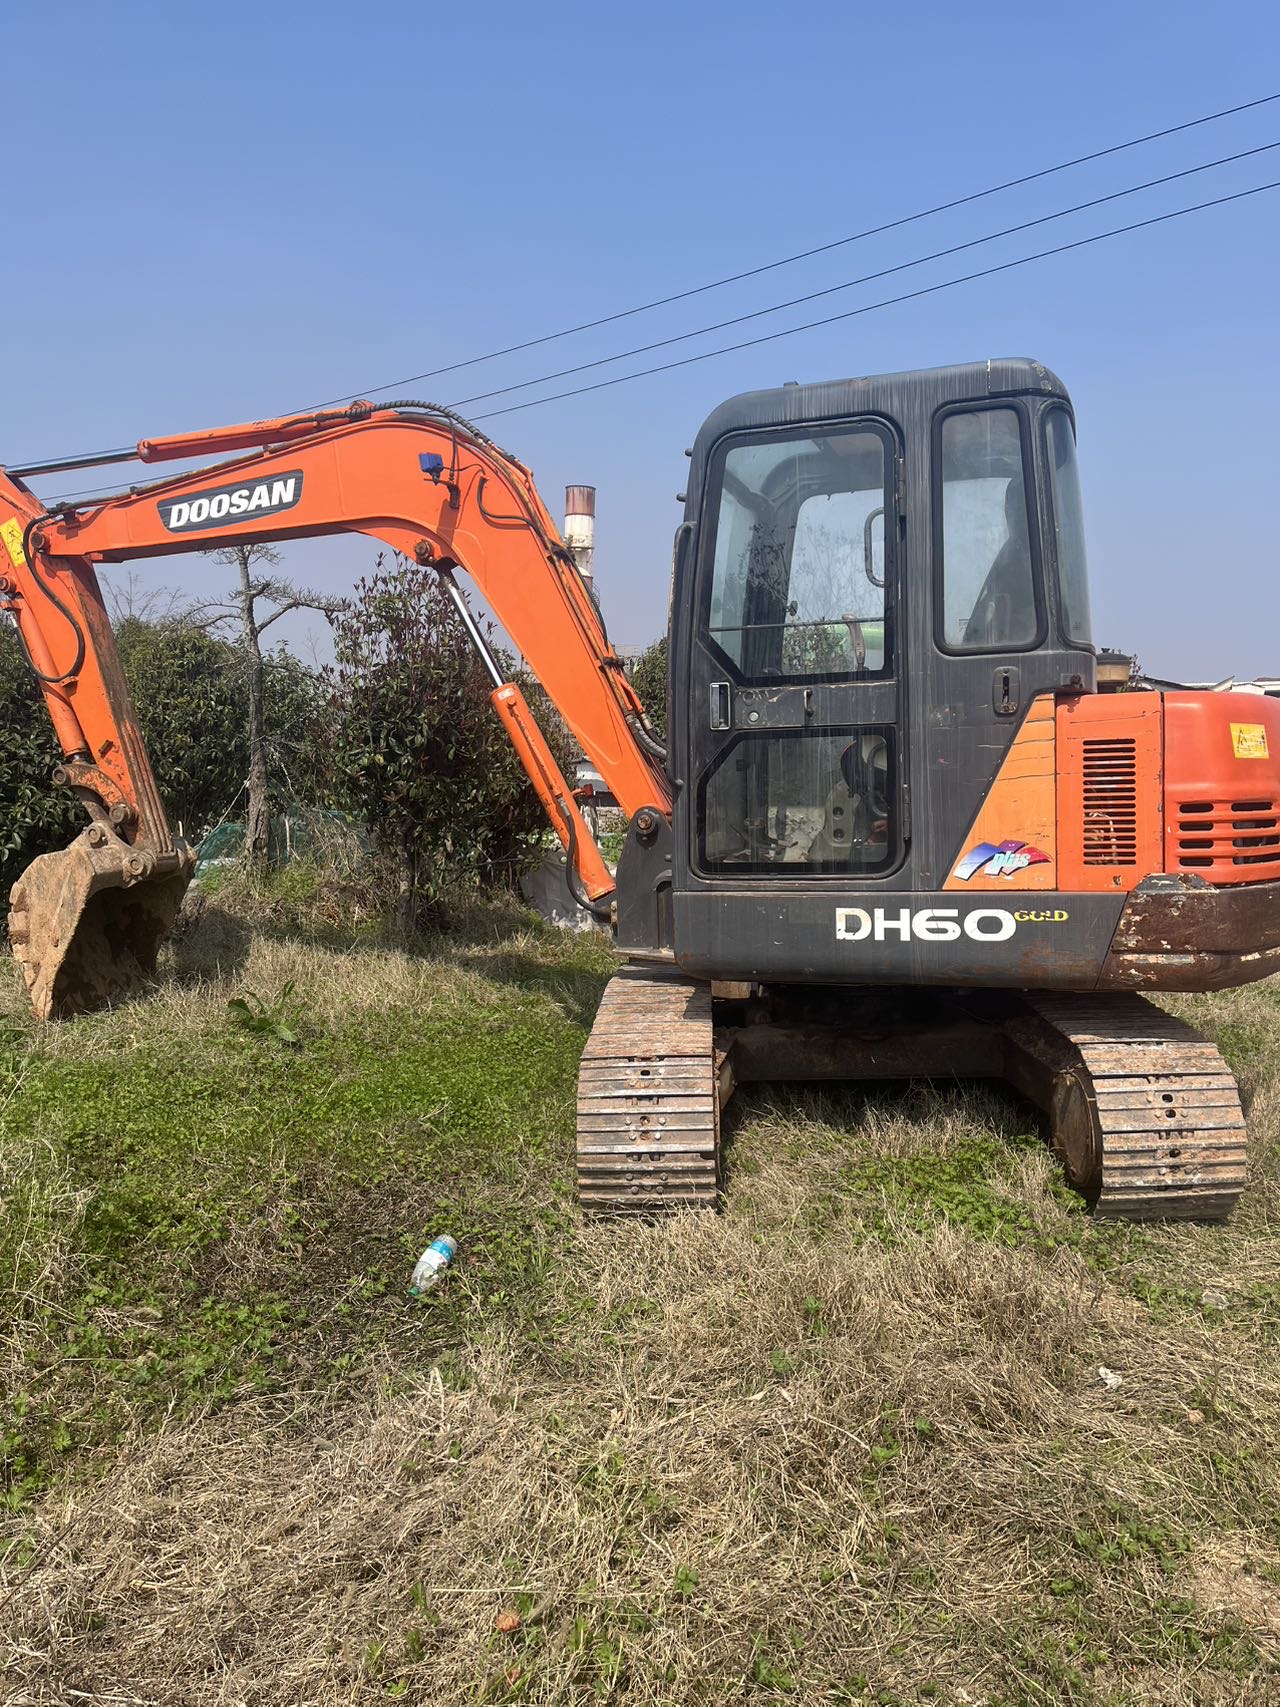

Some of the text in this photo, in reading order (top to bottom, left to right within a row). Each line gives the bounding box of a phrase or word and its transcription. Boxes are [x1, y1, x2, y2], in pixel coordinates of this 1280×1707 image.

[168, 478, 296, 529] DOOSAN
[990, 850, 1031, 870] plus
[835, 907, 1070, 942] DH60 GOLD
